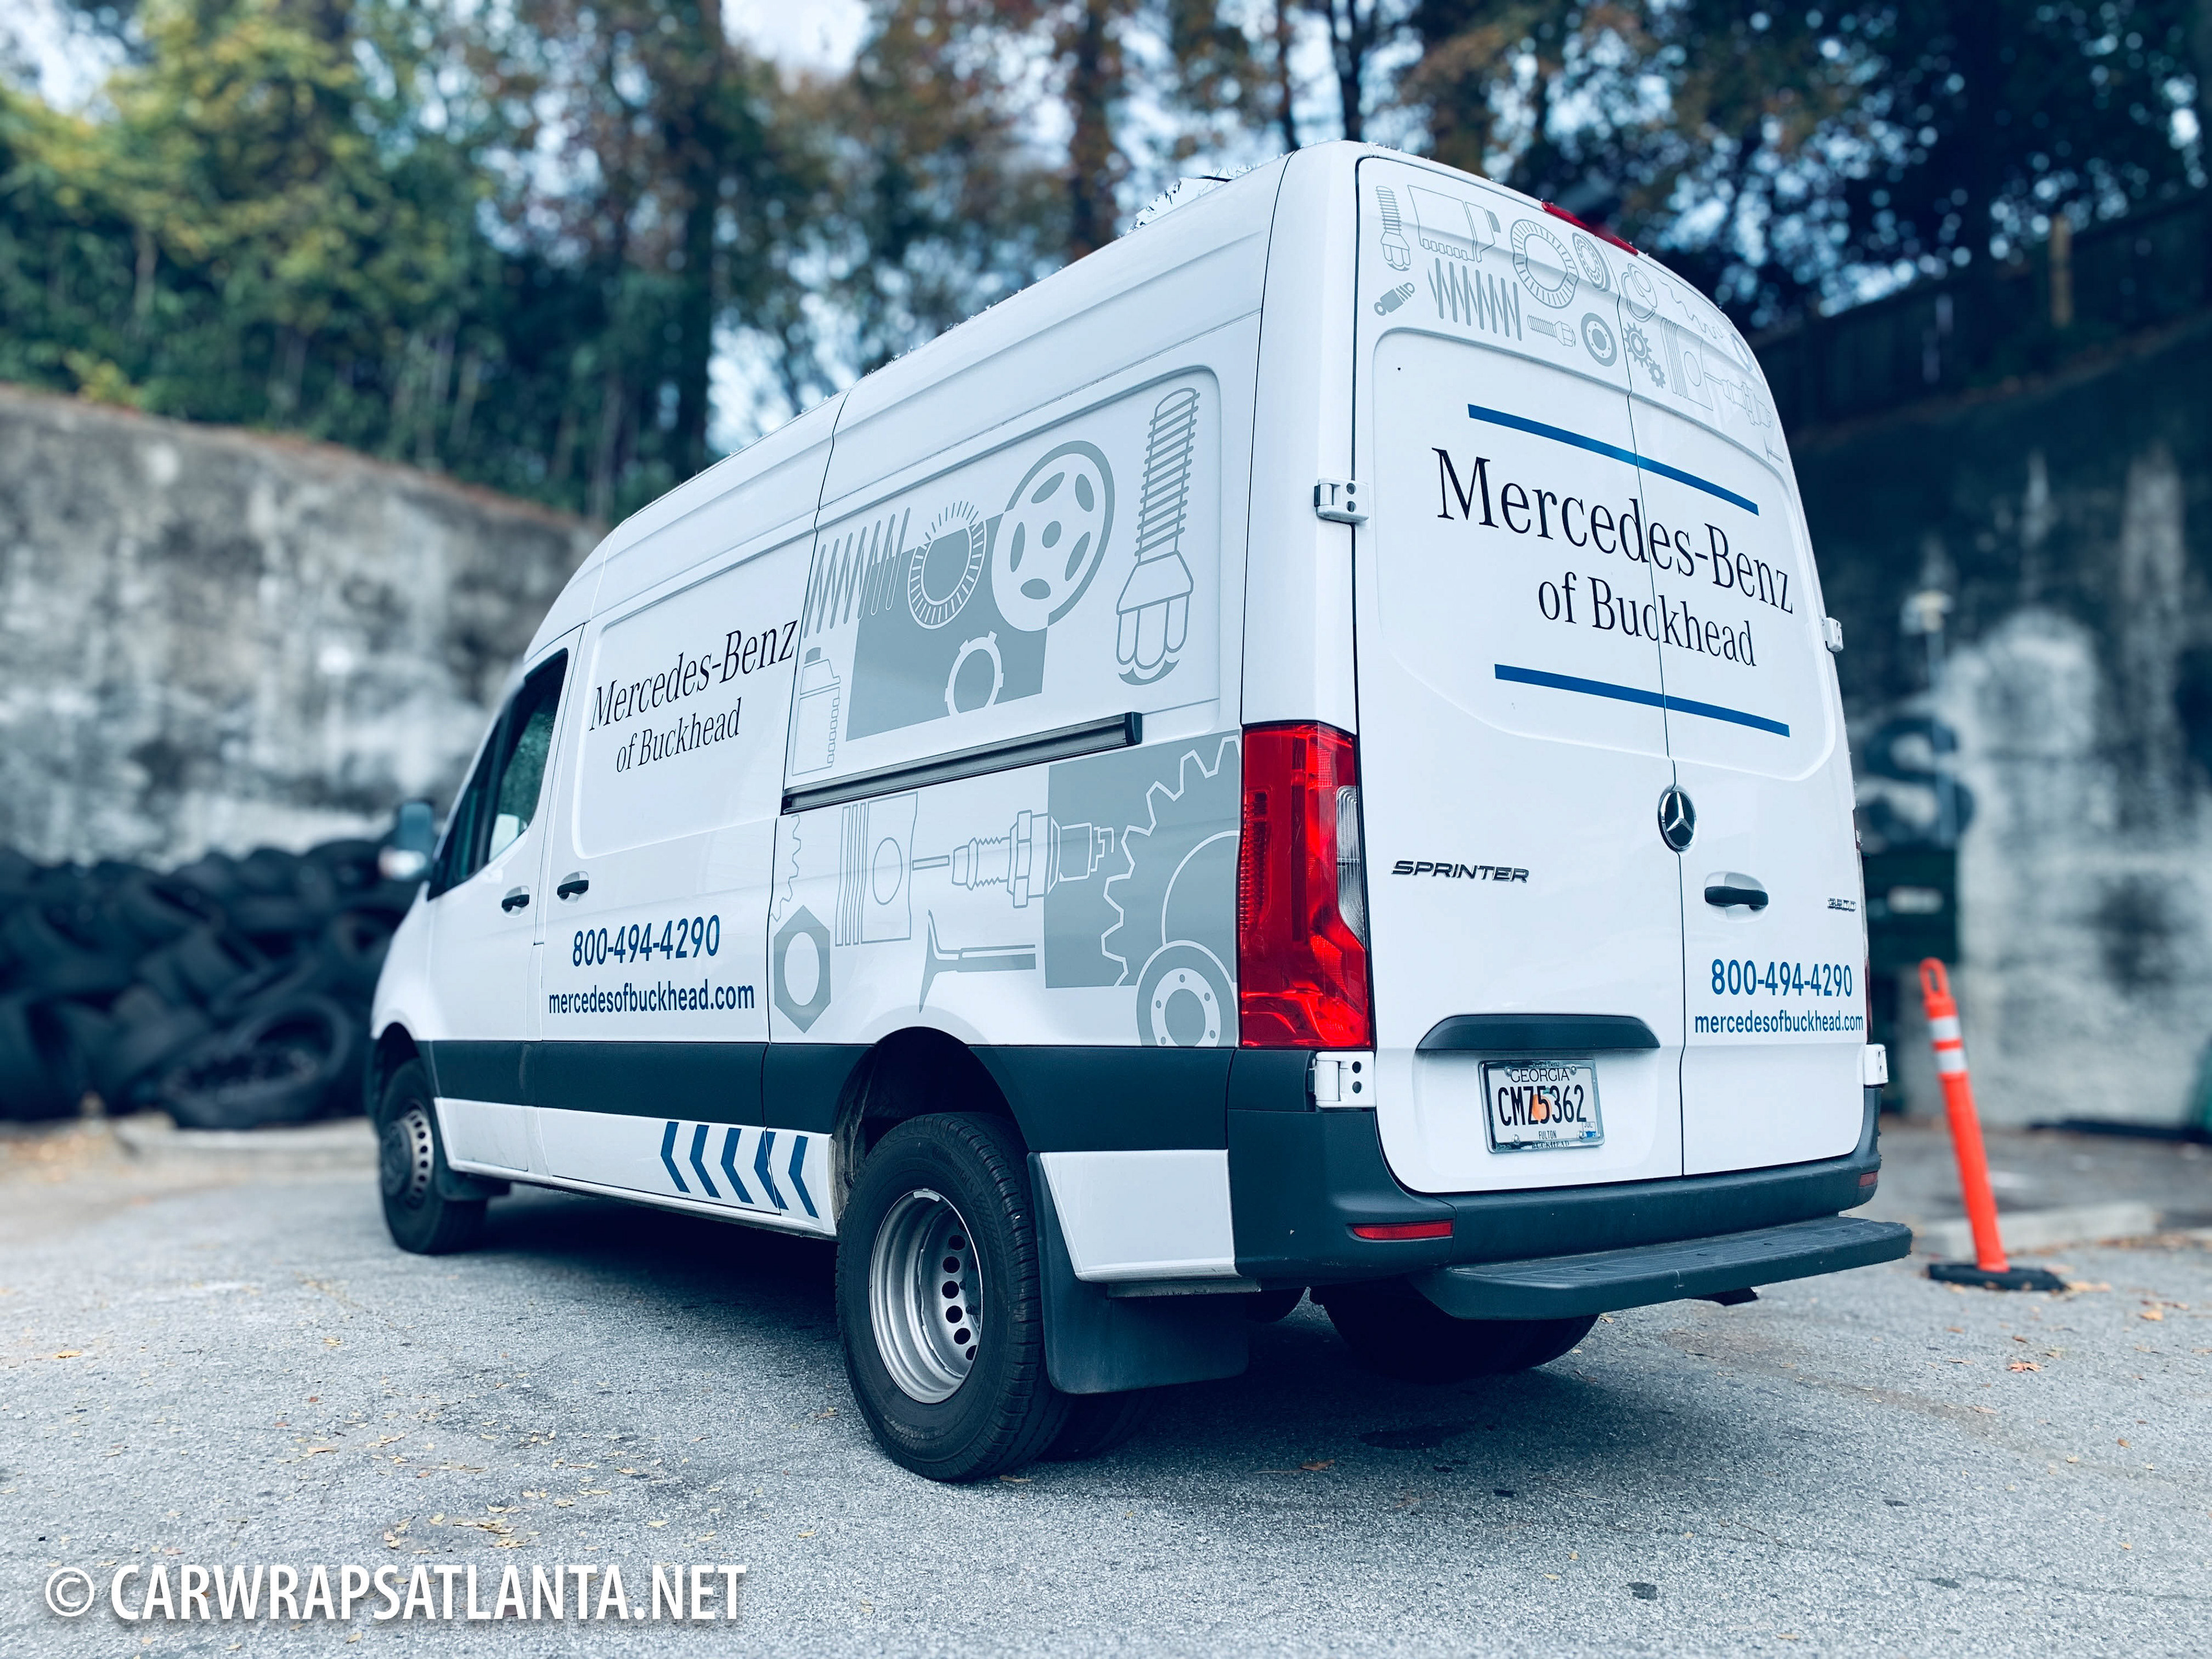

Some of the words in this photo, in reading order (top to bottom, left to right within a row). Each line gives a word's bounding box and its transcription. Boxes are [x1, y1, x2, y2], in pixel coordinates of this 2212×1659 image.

[1431, 447, 1793, 614] Mercedes-Benz
[1538, 571, 1577, 624] of
[1588, 577, 1757, 666] Buckhead
[589, 620, 798, 731] Mercedes-Benz
[616, 733, 637, 772] of
[638, 697, 742, 766] Buckhead
[1391, 860, 1529, 883] SPRINTER
[573, 915, 720, 967] 800-494-4290
[549, 979, 755, 1013] mercedesofbuckhead.com
[1711, 959, 1853, 998] 800-494-4290
[1695, 1009, 1863, 1033] mercedesofbuckhead.com
[1510, 1068, 1570, 1082] GEORGIA
[1498, 1084, 1586, 1126] CMZ5362
[1531, 1141, 1570, 1149] BUCKHEAD
[1538, 1130, 1557, 1140] FULTON
